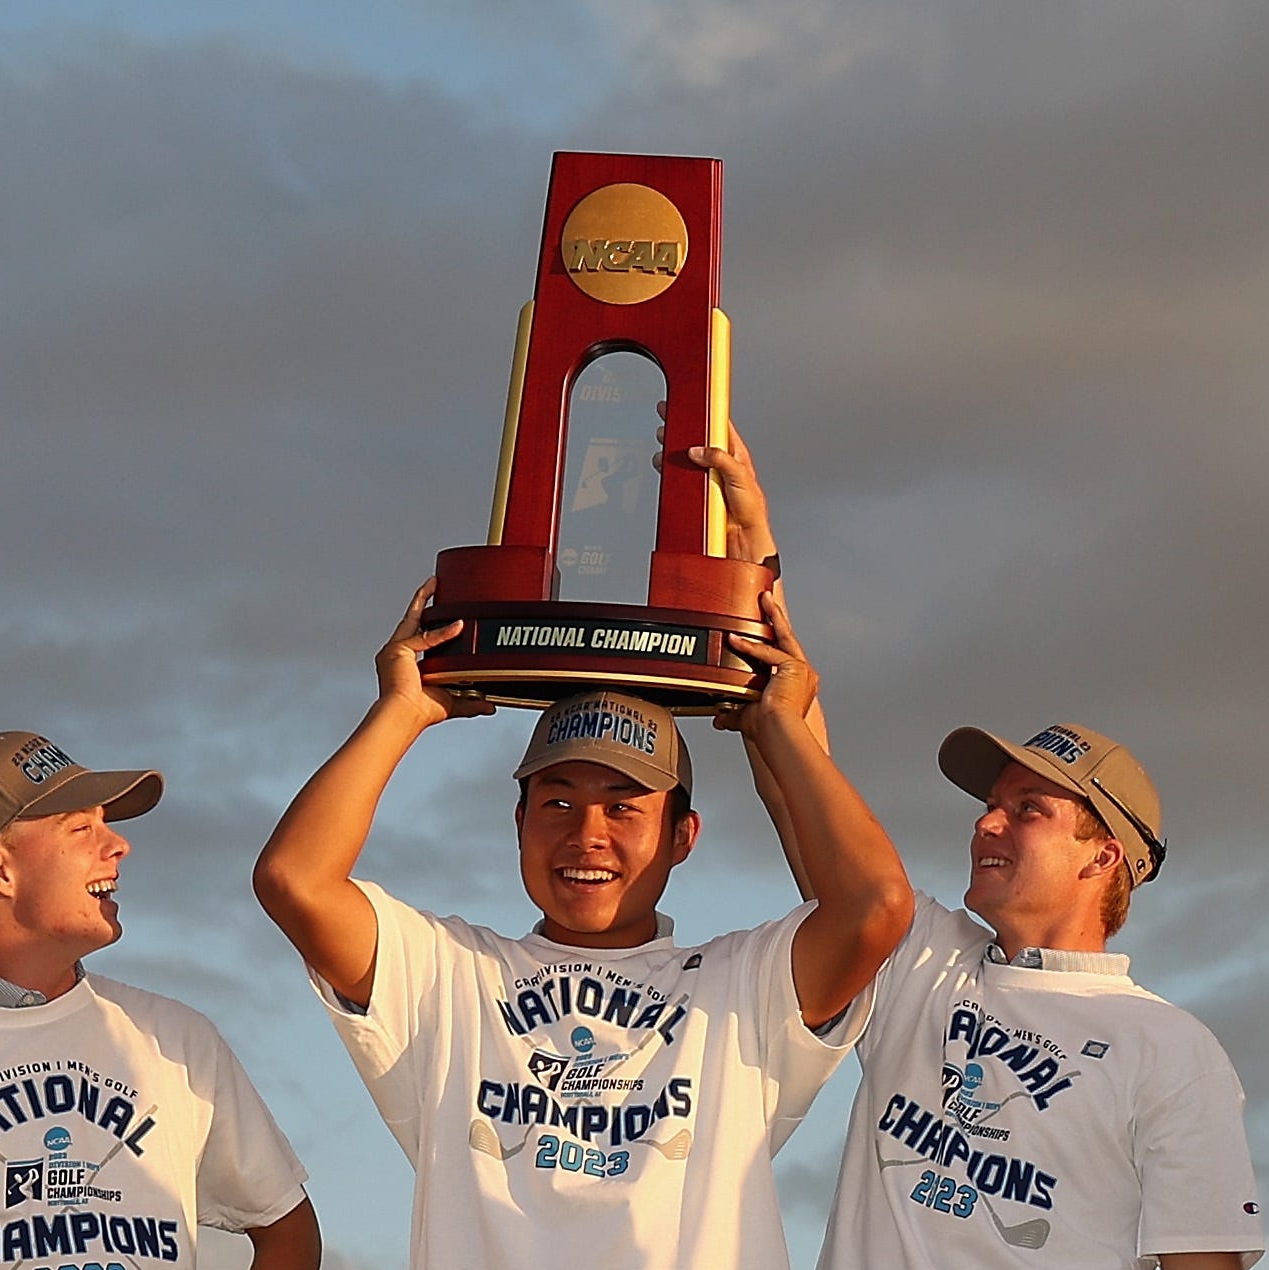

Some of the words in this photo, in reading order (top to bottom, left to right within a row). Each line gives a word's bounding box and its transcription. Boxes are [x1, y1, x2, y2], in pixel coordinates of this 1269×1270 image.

[569, 240, 683, 276] NCAA
[496, 626, 585, 648] NATIONAL
[590, 629, 697, 656] CHAMPION
[594, 700, 645, 724] NATIONAL
[546, 711, 659, 757] CHAMPIONS
[495, 976, 687, 1046] NATIONAL
[56, 1060, 62, 1070] I
[67, 1060, 100, 1083] MEN'S
[104, 1078, 139, 1099] GOLF
[561, 1079, 645, 1090] CHAMPIONSHIPS
[566, 1064, 605, 1079] GOLF
[535, 1133, 631, 1178] 2023
[47, 1169, 85, 1185] GOLF
[47, 1186, 122, 1202] CHAMPIONSHIPS
